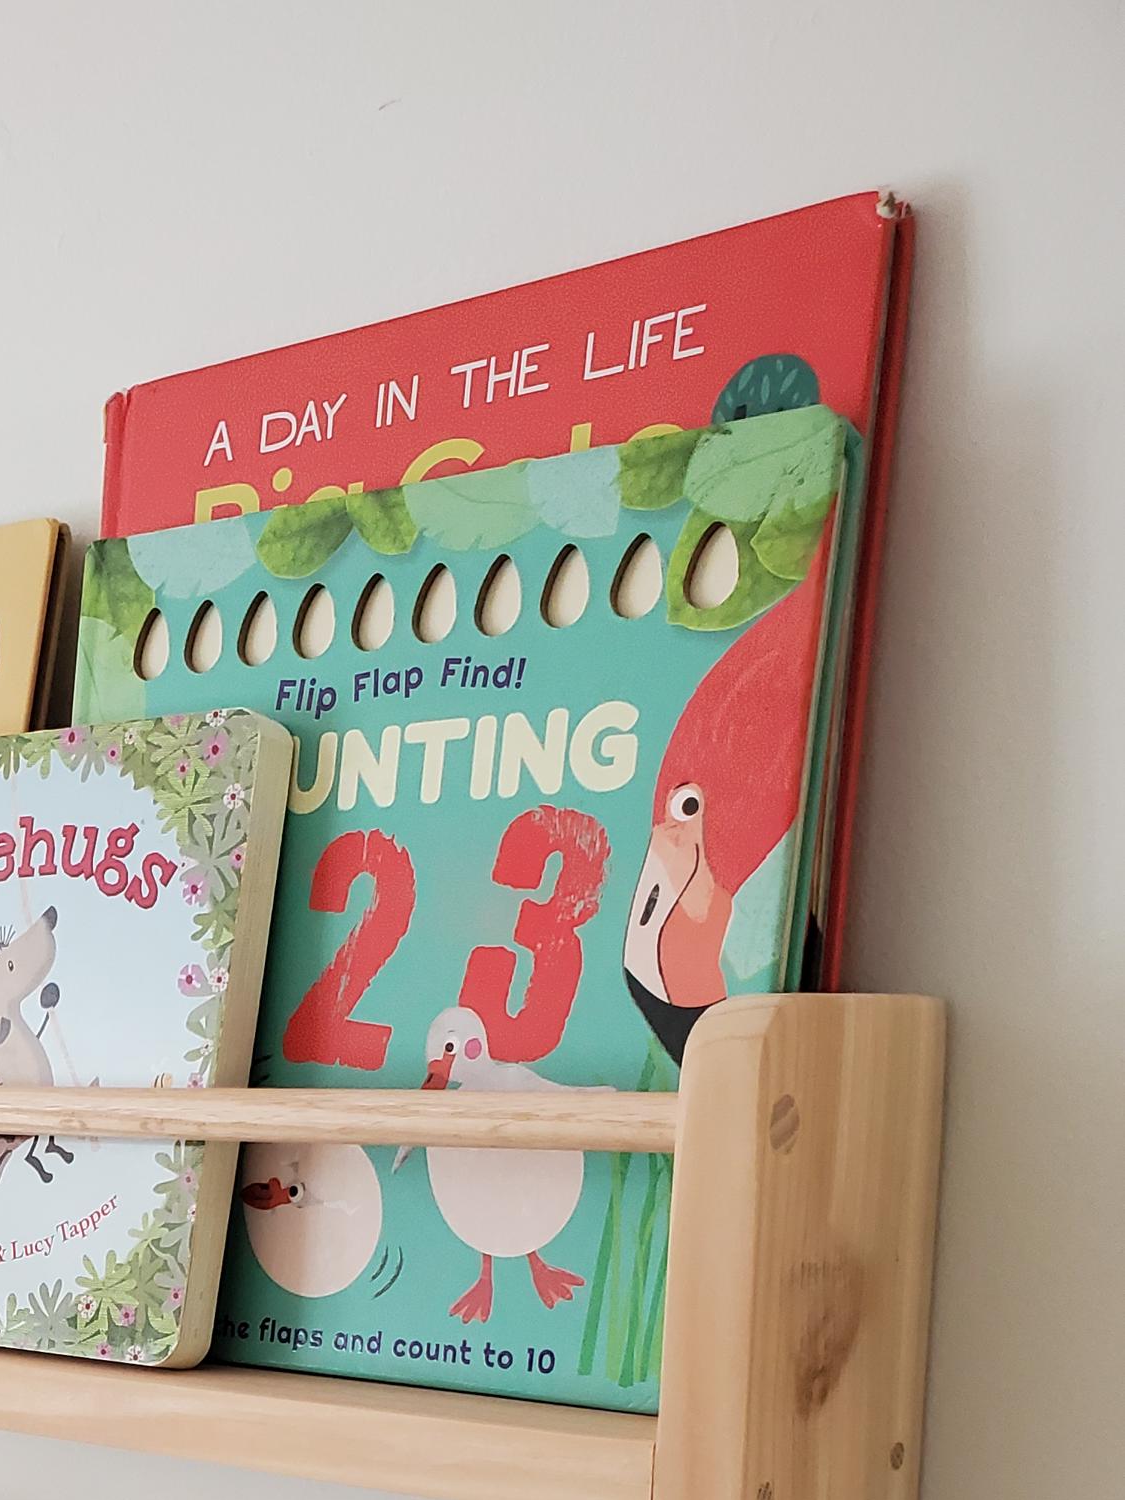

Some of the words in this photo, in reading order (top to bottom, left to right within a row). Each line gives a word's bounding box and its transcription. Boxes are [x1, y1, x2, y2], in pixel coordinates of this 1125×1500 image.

[203, 421, 234, 466] A
[260, 393, 348, 455] DAY
[375, 376, 419, 428] IN
[451, 343, 551, 409] THE
[583, 304, 707, 382] LIFE
[275, 678, 338, 720] Flip
[352, 667, 424, 702] Flap
[440, 655, 527, 689] Find!
[282, 828, 417, 1071] 2
[458, 804, 613, 1064] 3
[11, 1234, 55, 1260] Lucy
[56, 1195, 118, 1243] Tapper
[219, 1314, 250, 1340] he
[259, 1317, 323, 1352] flaps
[333, 1330, 383, 1355] and
[392, 1334, 472, 1366] count
[482, 1342, 514, 1371] to
[526, 1347, 557, 1375] 10
